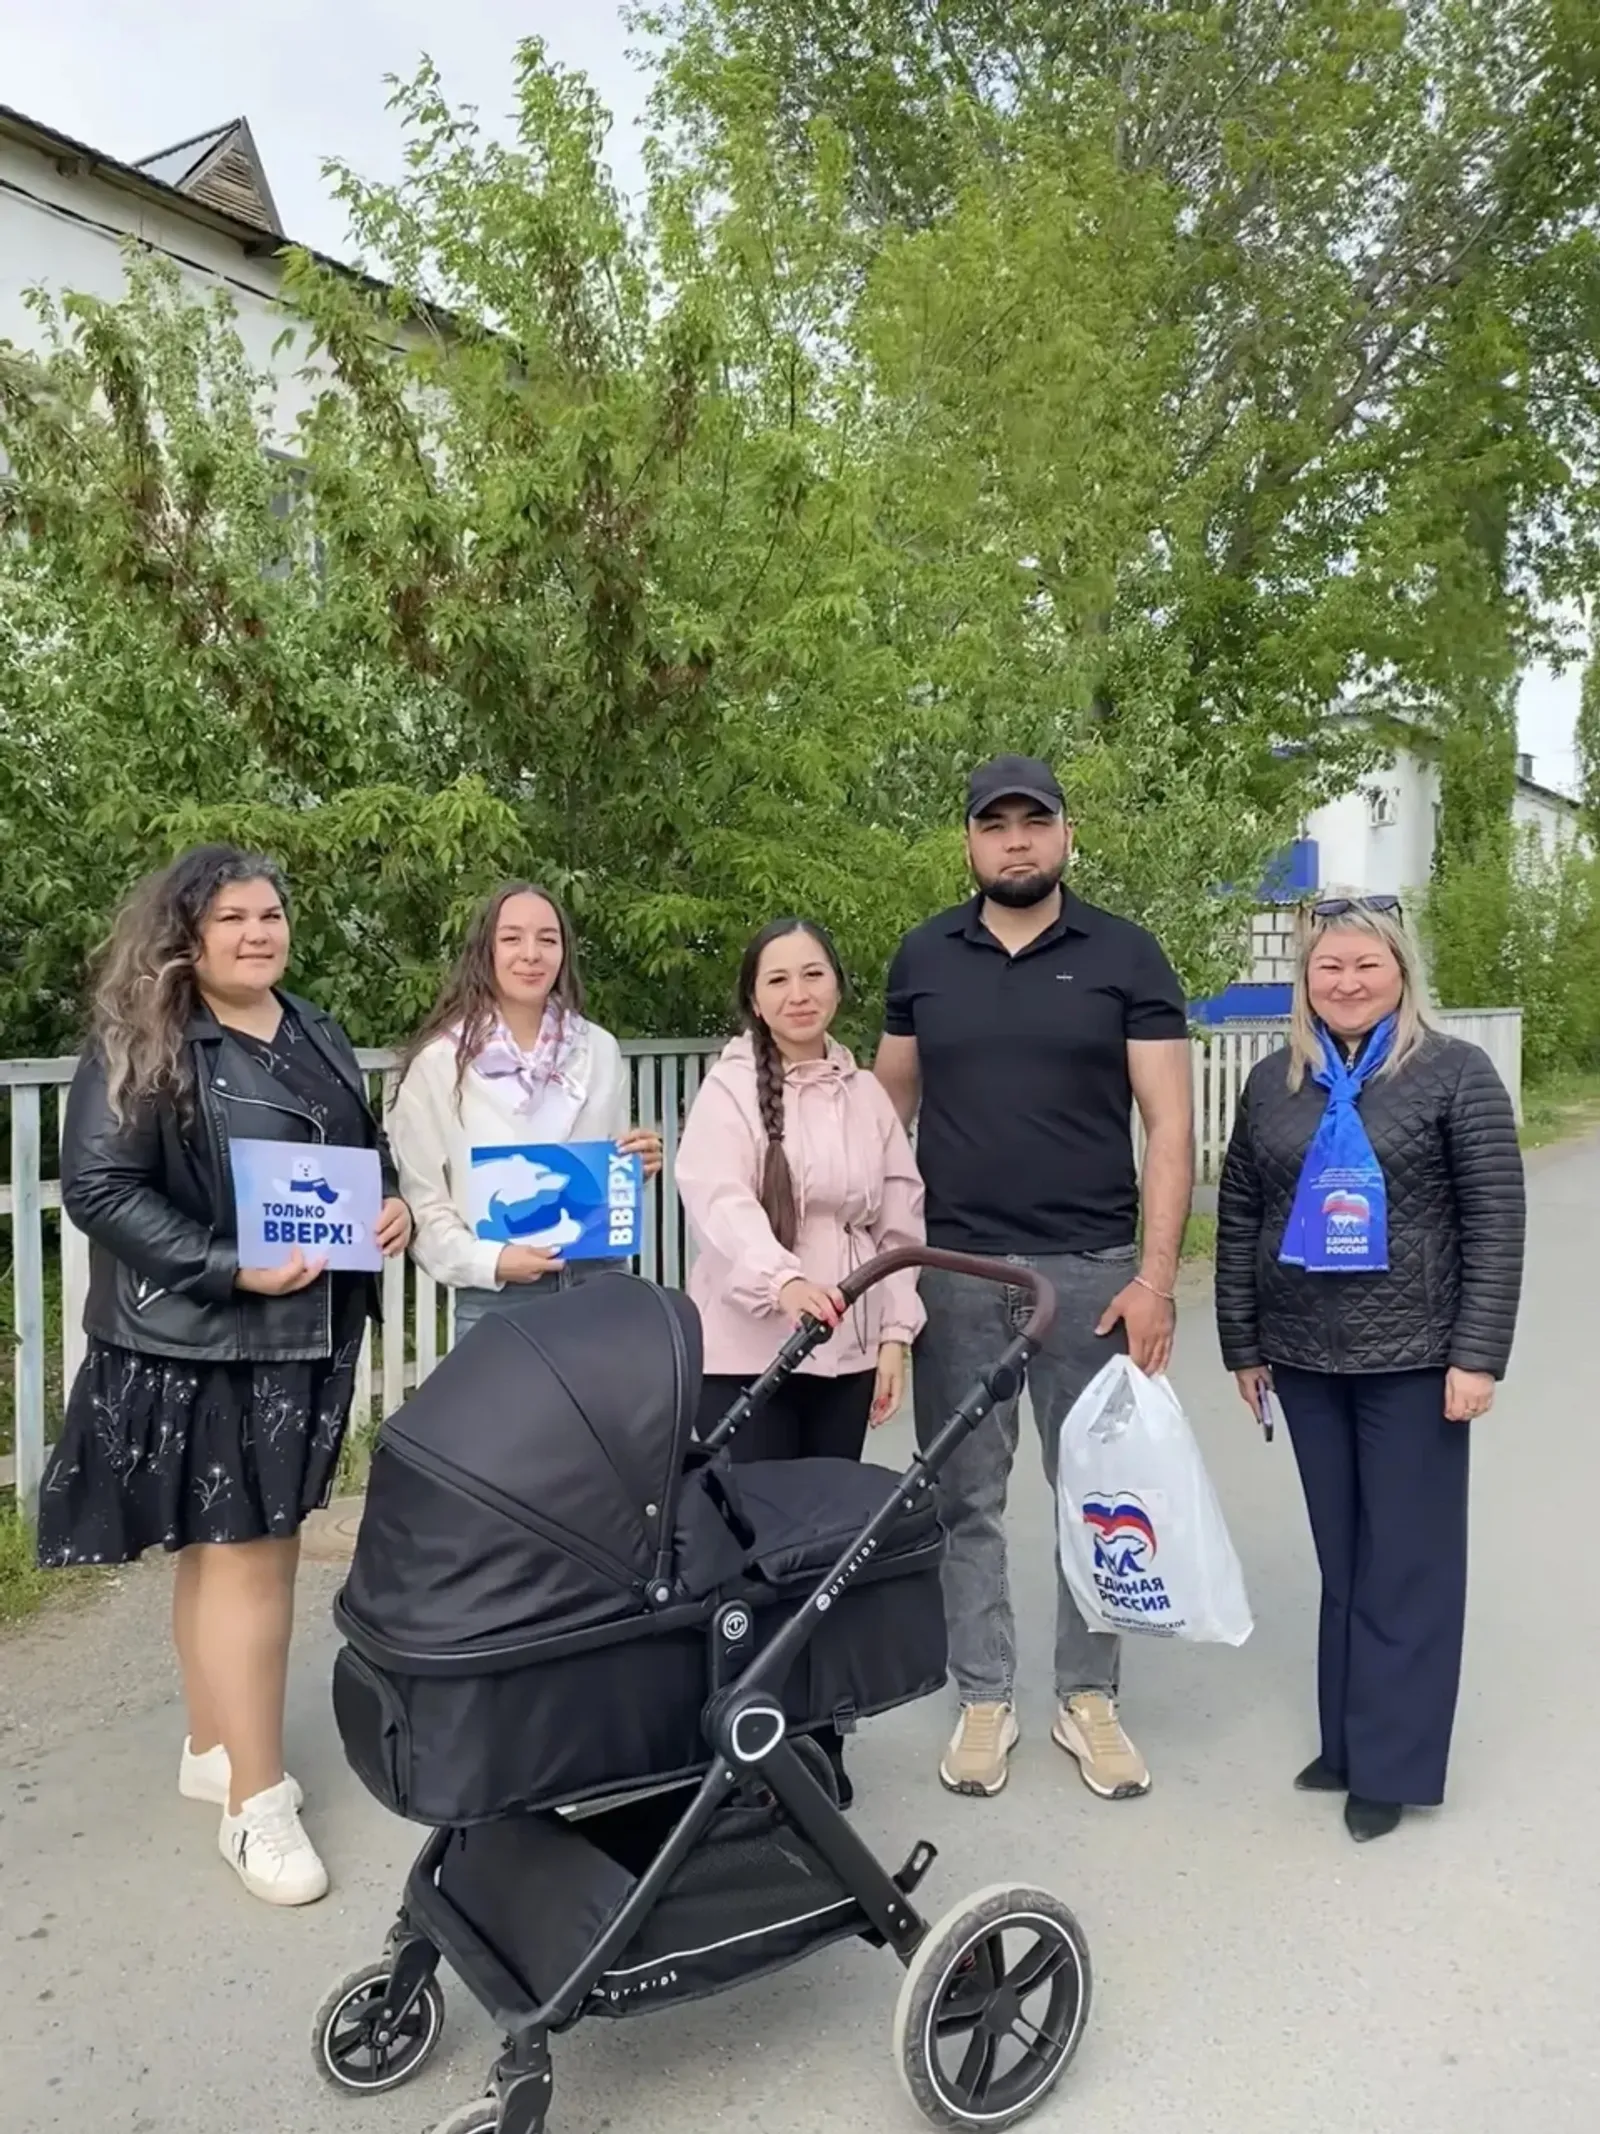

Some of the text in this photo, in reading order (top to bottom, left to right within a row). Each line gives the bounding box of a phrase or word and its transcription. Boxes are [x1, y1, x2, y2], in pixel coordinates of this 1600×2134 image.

[263, 1203, 326, 1219] ТОЛЬКО
[608, 1153, 636, 1246] ВВЕРХ
[264, 1220, 353, 1245] ВВЕРХ!
[1093, 1573, 1165, 1596] ЕДИНАЯ
[1098, 1588, 1171, 1612] РОССИЯ
